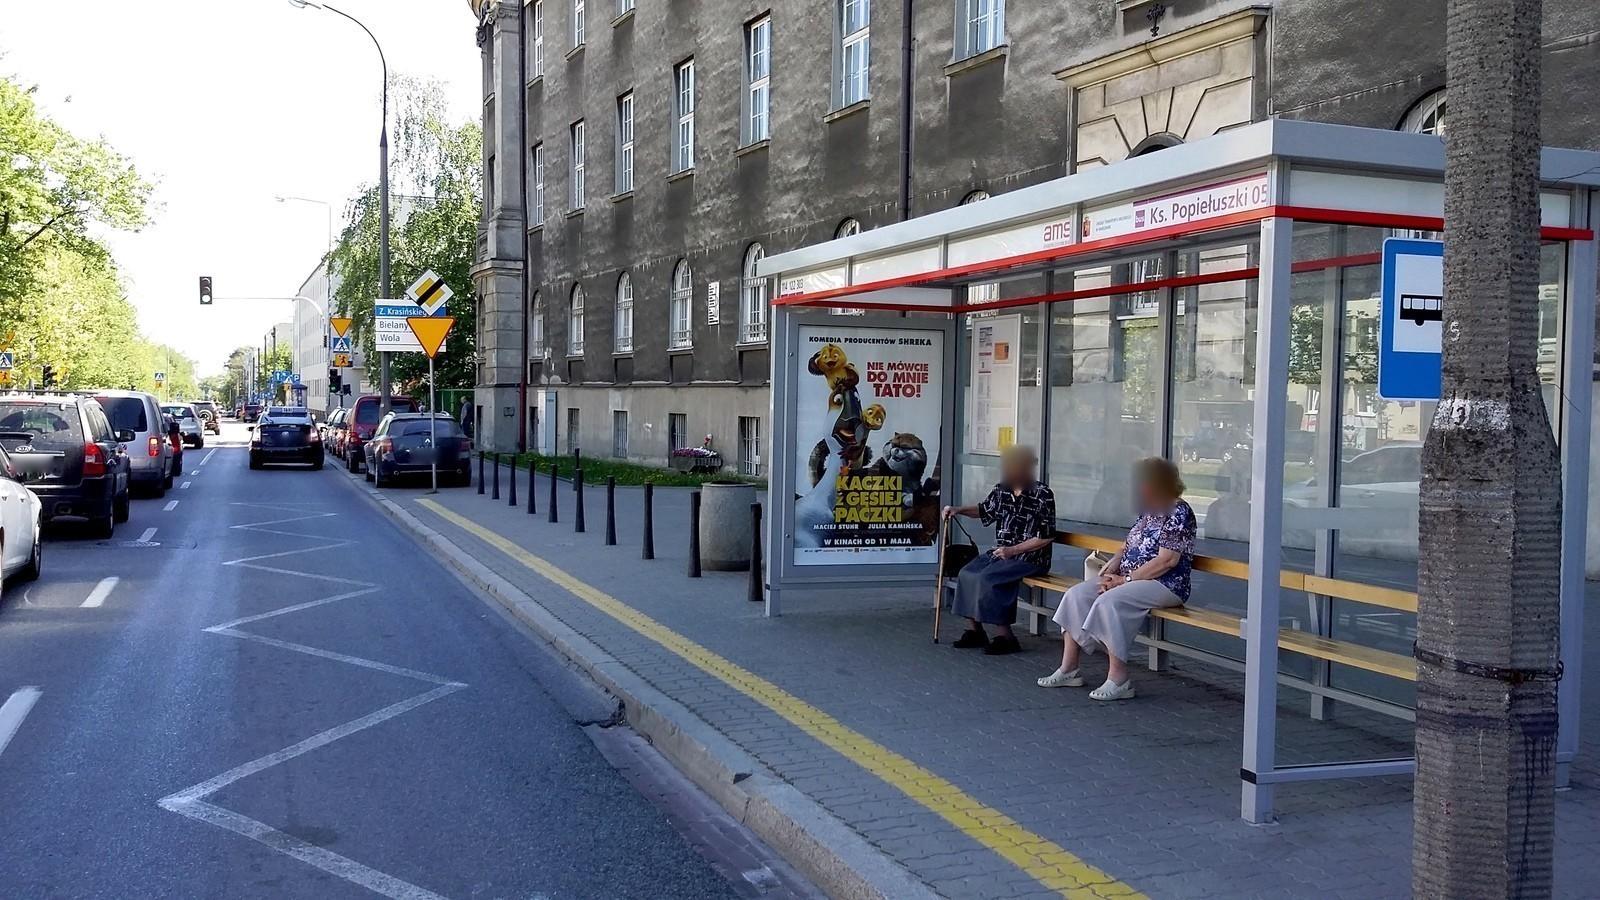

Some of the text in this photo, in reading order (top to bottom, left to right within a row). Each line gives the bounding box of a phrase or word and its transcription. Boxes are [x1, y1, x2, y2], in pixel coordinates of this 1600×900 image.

[1150, 207, 1168, 224] Ks.
[1172, 187, 1248, 221] Popiełuszki
[1043, 221, 1071, 241] ams
[387, 308, 427, 317] Krasińskieg
[379, 321, 408, 330] Bielany
[380, 334, 400, 342] Wola
[844, 336, 896, 345] PRODUCENTÓW
[898, 338, 932, 346] SHREKA
[867, 361, 929, 372] NIE MÓWCIE
[867, 372, 929, 384] DO MNIE
[873, 384, 921, 398] TATO!
[836, 475, 902, 491] KACZKI
[846, 491, 902, 508] GĘSIEJ
[834, 507, 902, 523] PACZKI
[887, 521, 923, 530] KAMIŃSKA
